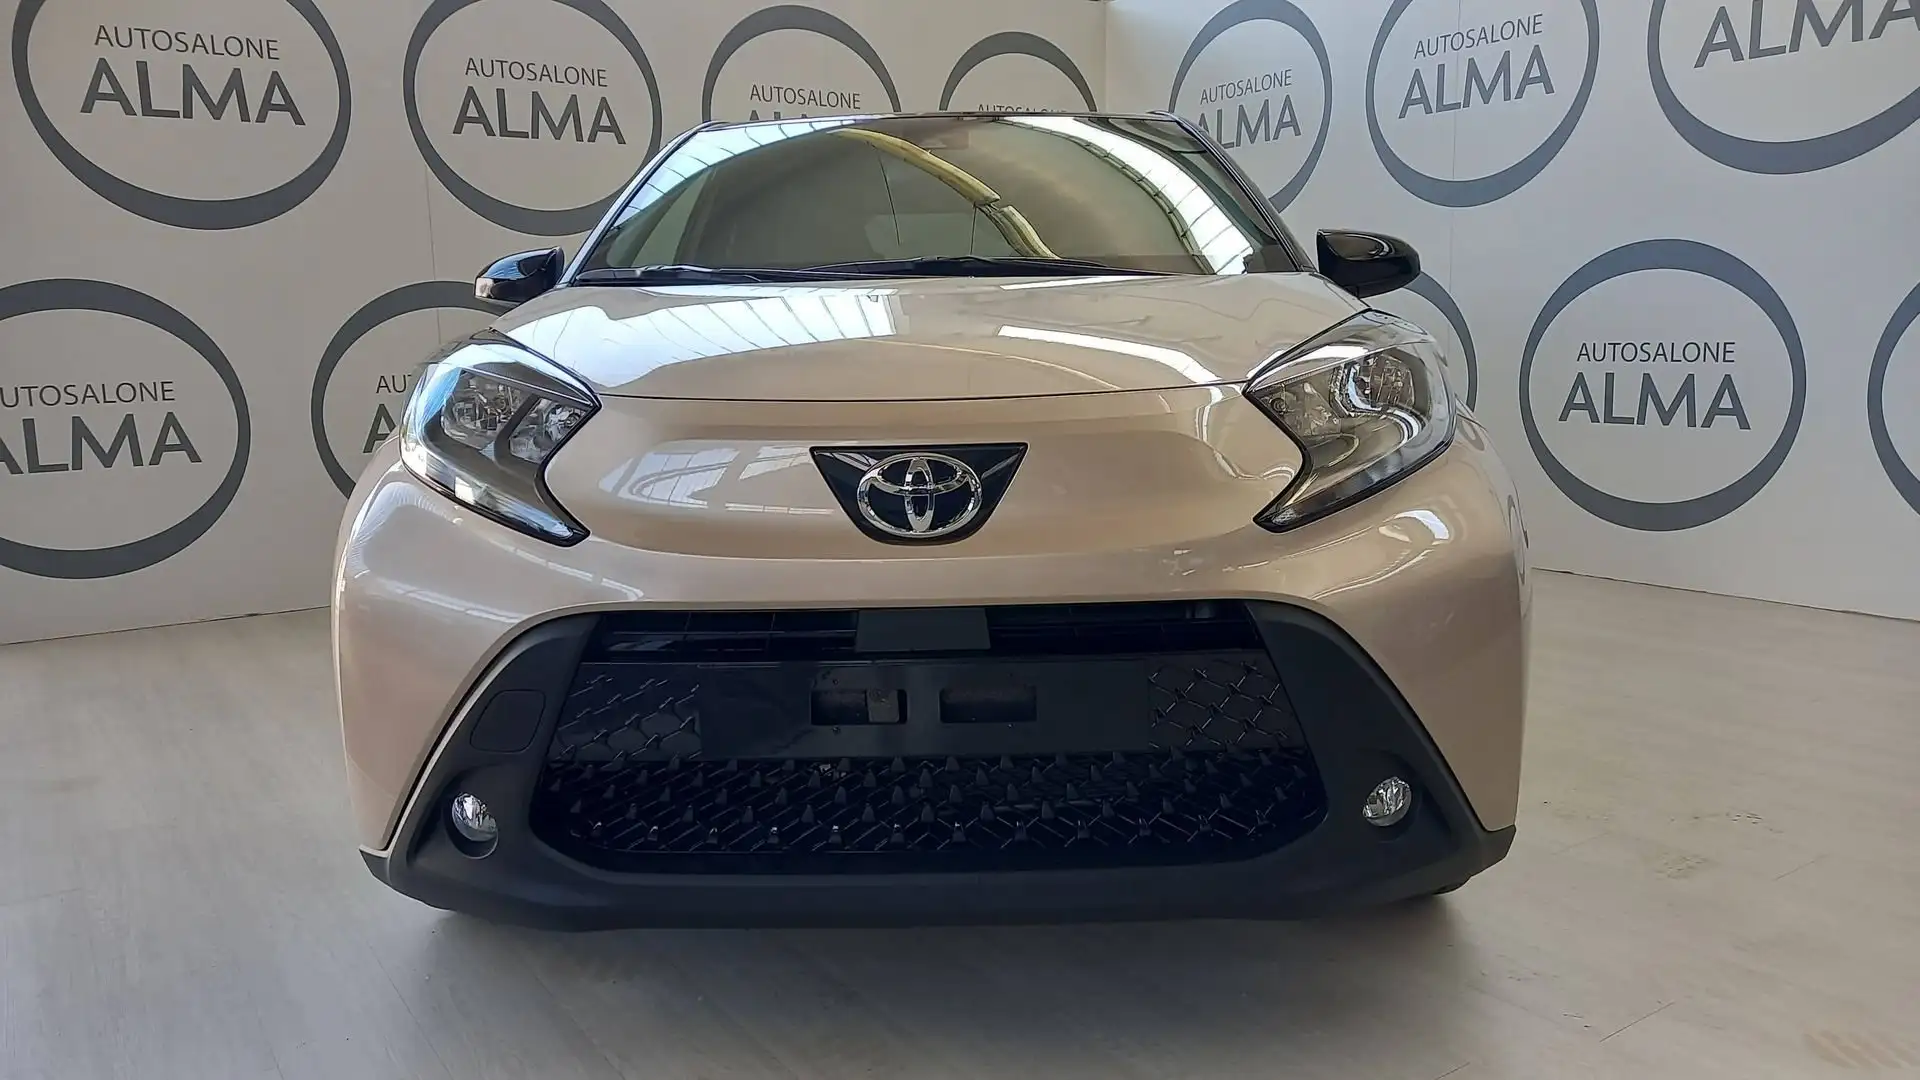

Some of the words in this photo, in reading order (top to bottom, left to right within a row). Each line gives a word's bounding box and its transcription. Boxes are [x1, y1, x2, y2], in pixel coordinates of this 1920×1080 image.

[94, 24, 280, 60] AUTOSALONE
[1414, 13, 1543, 60] AUTOSALONE
[465, 57, 608, 88] AUTOSALONE
[1200, 69, 1292, 105] AUTOSALONE
[1398, 44, 1555, 119] ALMA
[80, 57, 306, 126] ALMA
[750, 84, 861, 109] AUTOSALONE
[452, 86, 627, 145] ALMA
[1576, 341, 1736, 363] AUTOSALONE
[0, 381, 176, 408] UTOSALONE
[1558, 372, 1752, 430] ALMA
